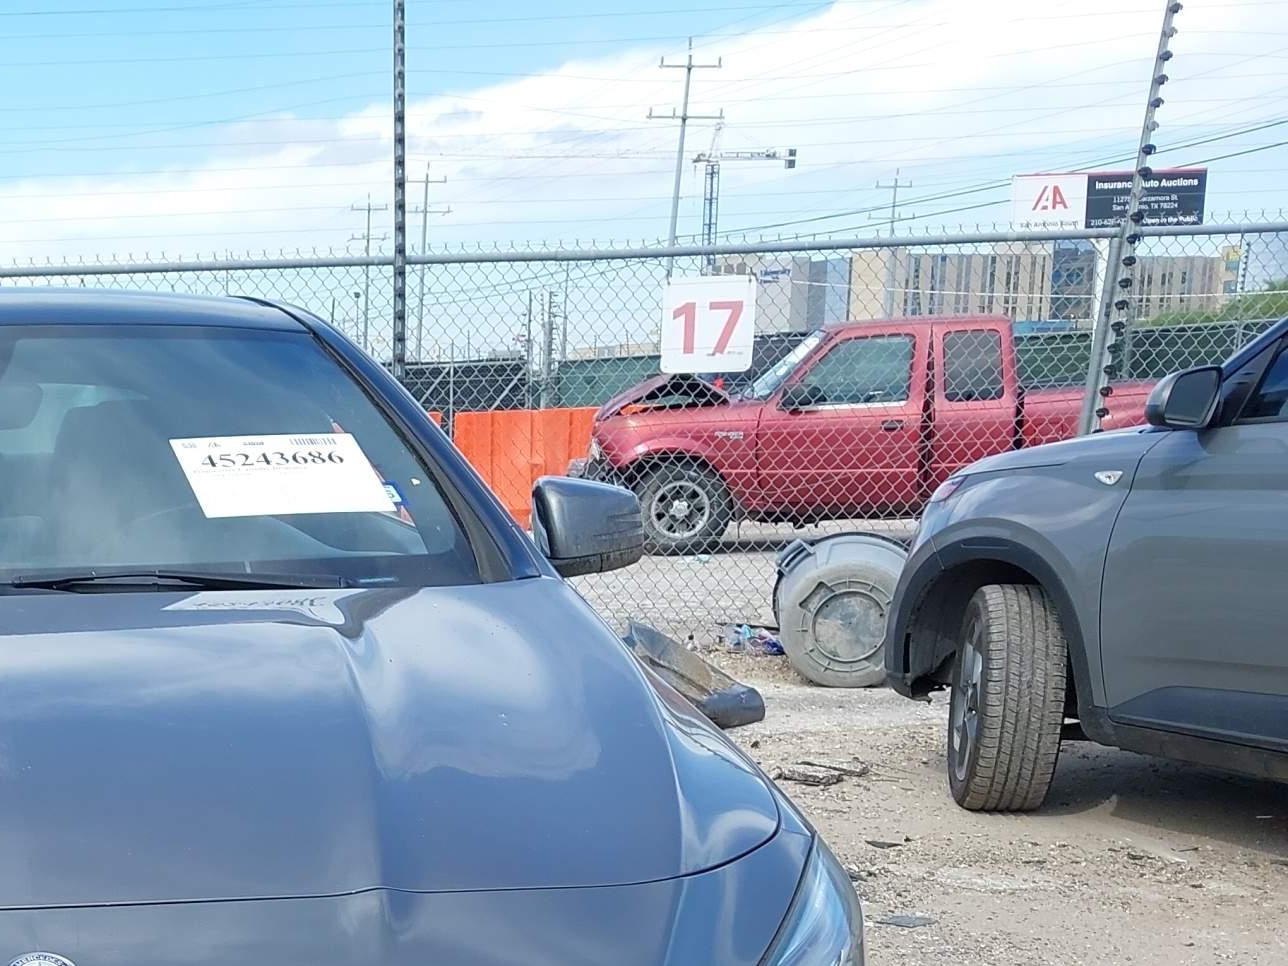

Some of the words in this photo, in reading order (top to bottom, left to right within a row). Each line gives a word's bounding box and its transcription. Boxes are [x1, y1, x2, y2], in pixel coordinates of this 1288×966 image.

[1095, 181, 1133, 190] Insuranc
[1160, 177, 1199, 187] Auctions
[672, 300, 744, 355] 17
[201, 450, 345, 468] 45243686
